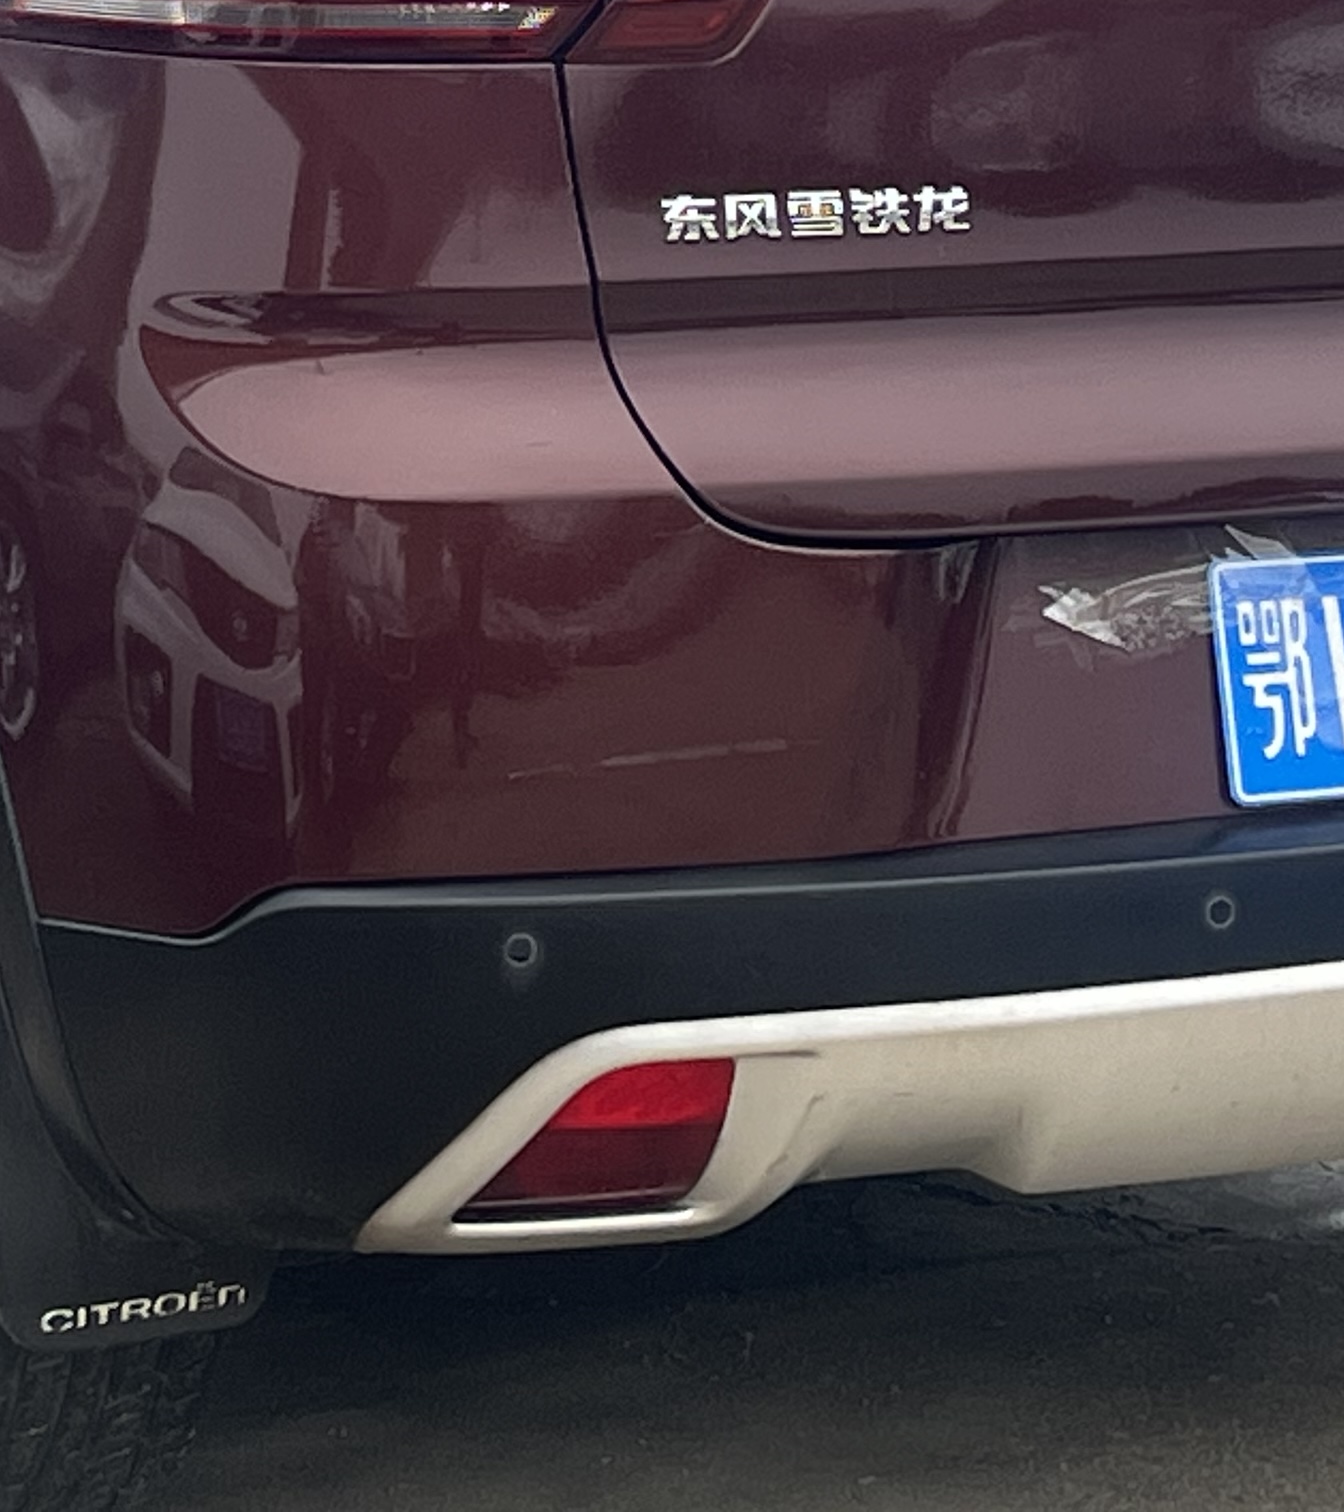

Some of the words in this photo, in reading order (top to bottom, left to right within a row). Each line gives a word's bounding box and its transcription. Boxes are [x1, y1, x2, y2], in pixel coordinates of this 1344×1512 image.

[660, 185, 972, 242] 东风雪铁龙
